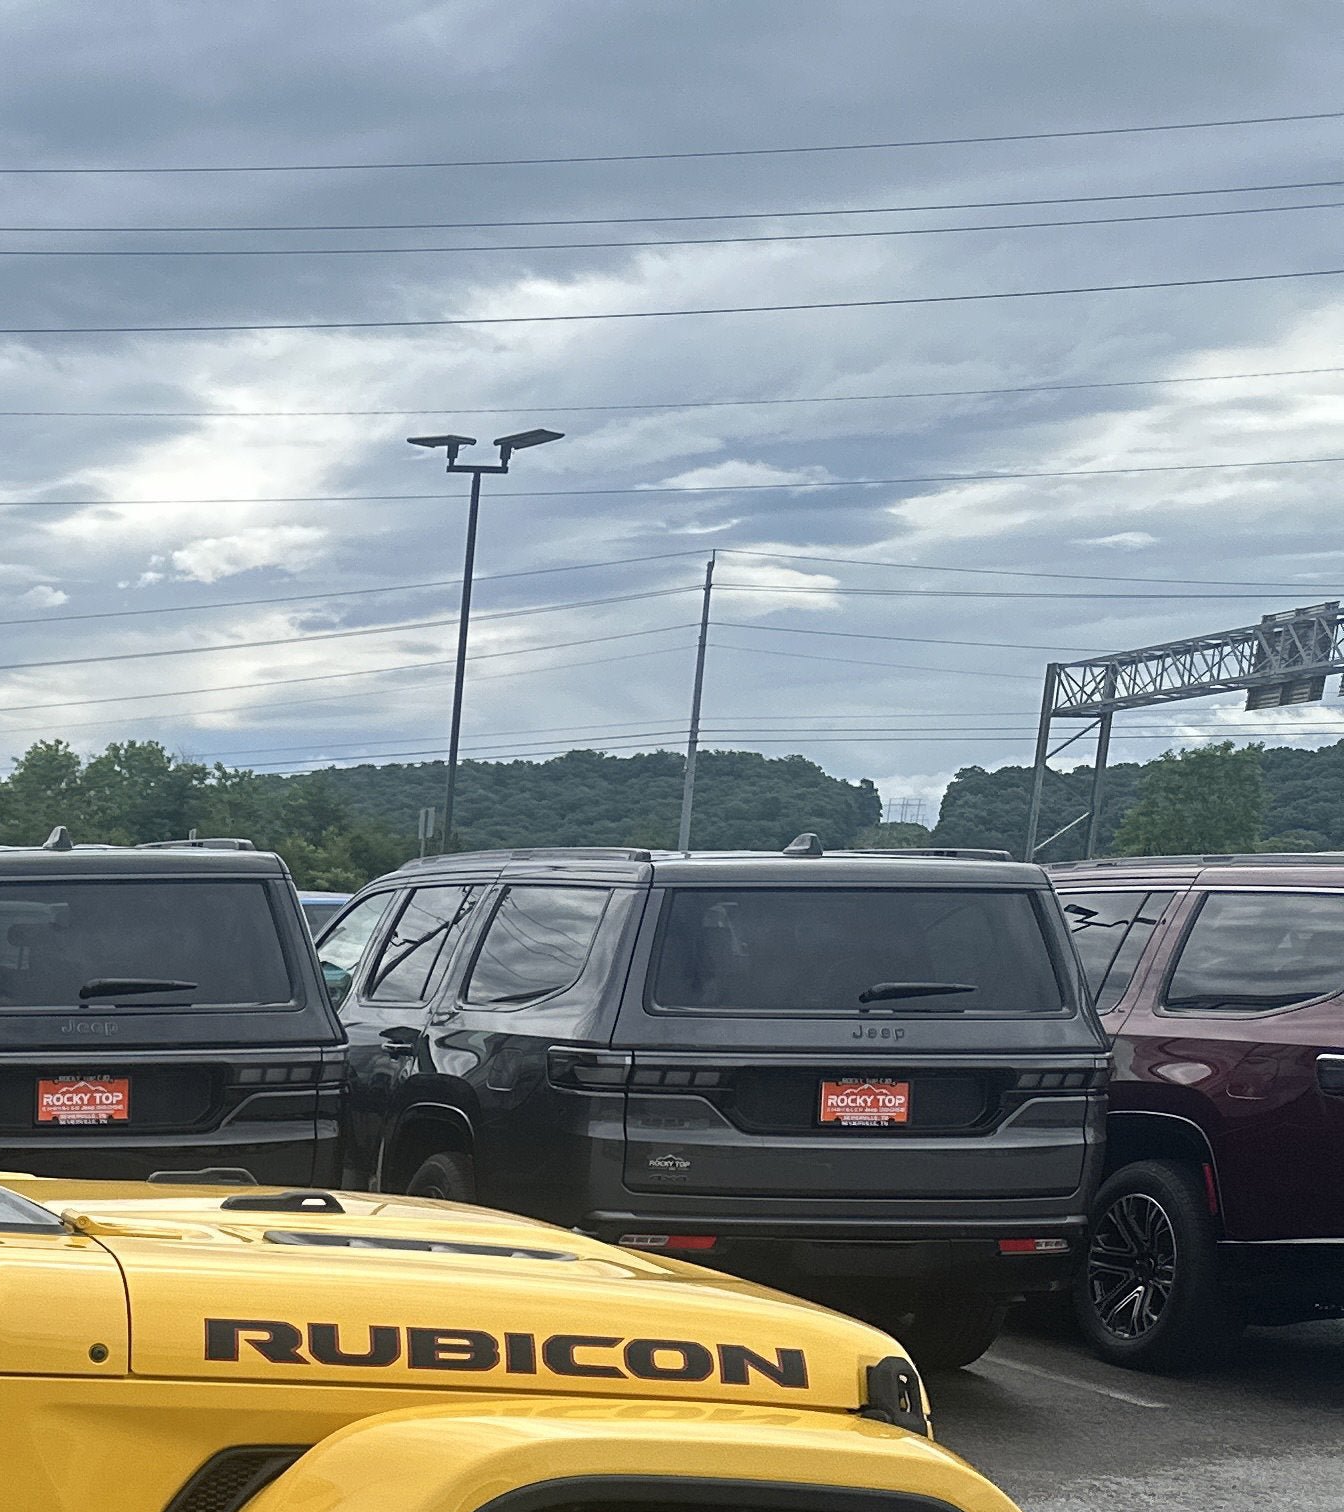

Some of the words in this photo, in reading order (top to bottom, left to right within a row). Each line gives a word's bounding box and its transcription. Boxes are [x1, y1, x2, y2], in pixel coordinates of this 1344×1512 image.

[61, 1019, 119, 1036] Jeep
[852, 1025, 905, 1041] Jeep
[43, 1093, 91, 1105] ROCKY
[93, 1092, 123, 1104] TOP
[827, 1095, 874, 1107] ROCKY
[877, 1095, 905, 1106] TOP
[204, 1318, 810, 1390] RUBICON
